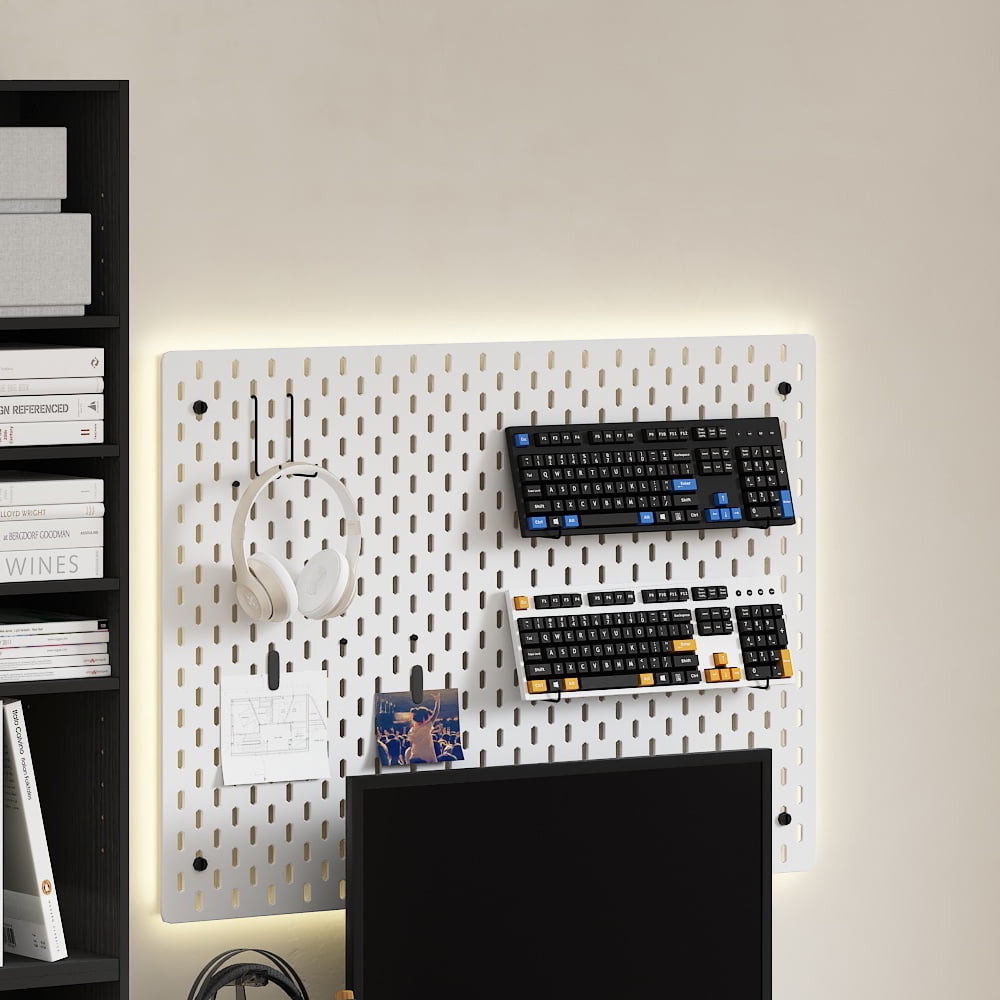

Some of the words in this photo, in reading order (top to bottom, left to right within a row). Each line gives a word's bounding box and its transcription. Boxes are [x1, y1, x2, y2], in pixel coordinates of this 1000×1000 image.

[12, 403, 69, 415] REFERENCED
[0, 510, 20, 518] LLOYD
[22, 509, 46, 517] WRIGHT
[9, 531, 39, 541] BERGDORF
[39, 530, 70, 540] GOODMAN
[5, 554, 79, 576] WINES
[12, 709, 20, 726] Italo
[15, 726, 25, 755] Calvino
[20, 757, 28, 776] Italian
[24, 776, 33, 801] Folktales
